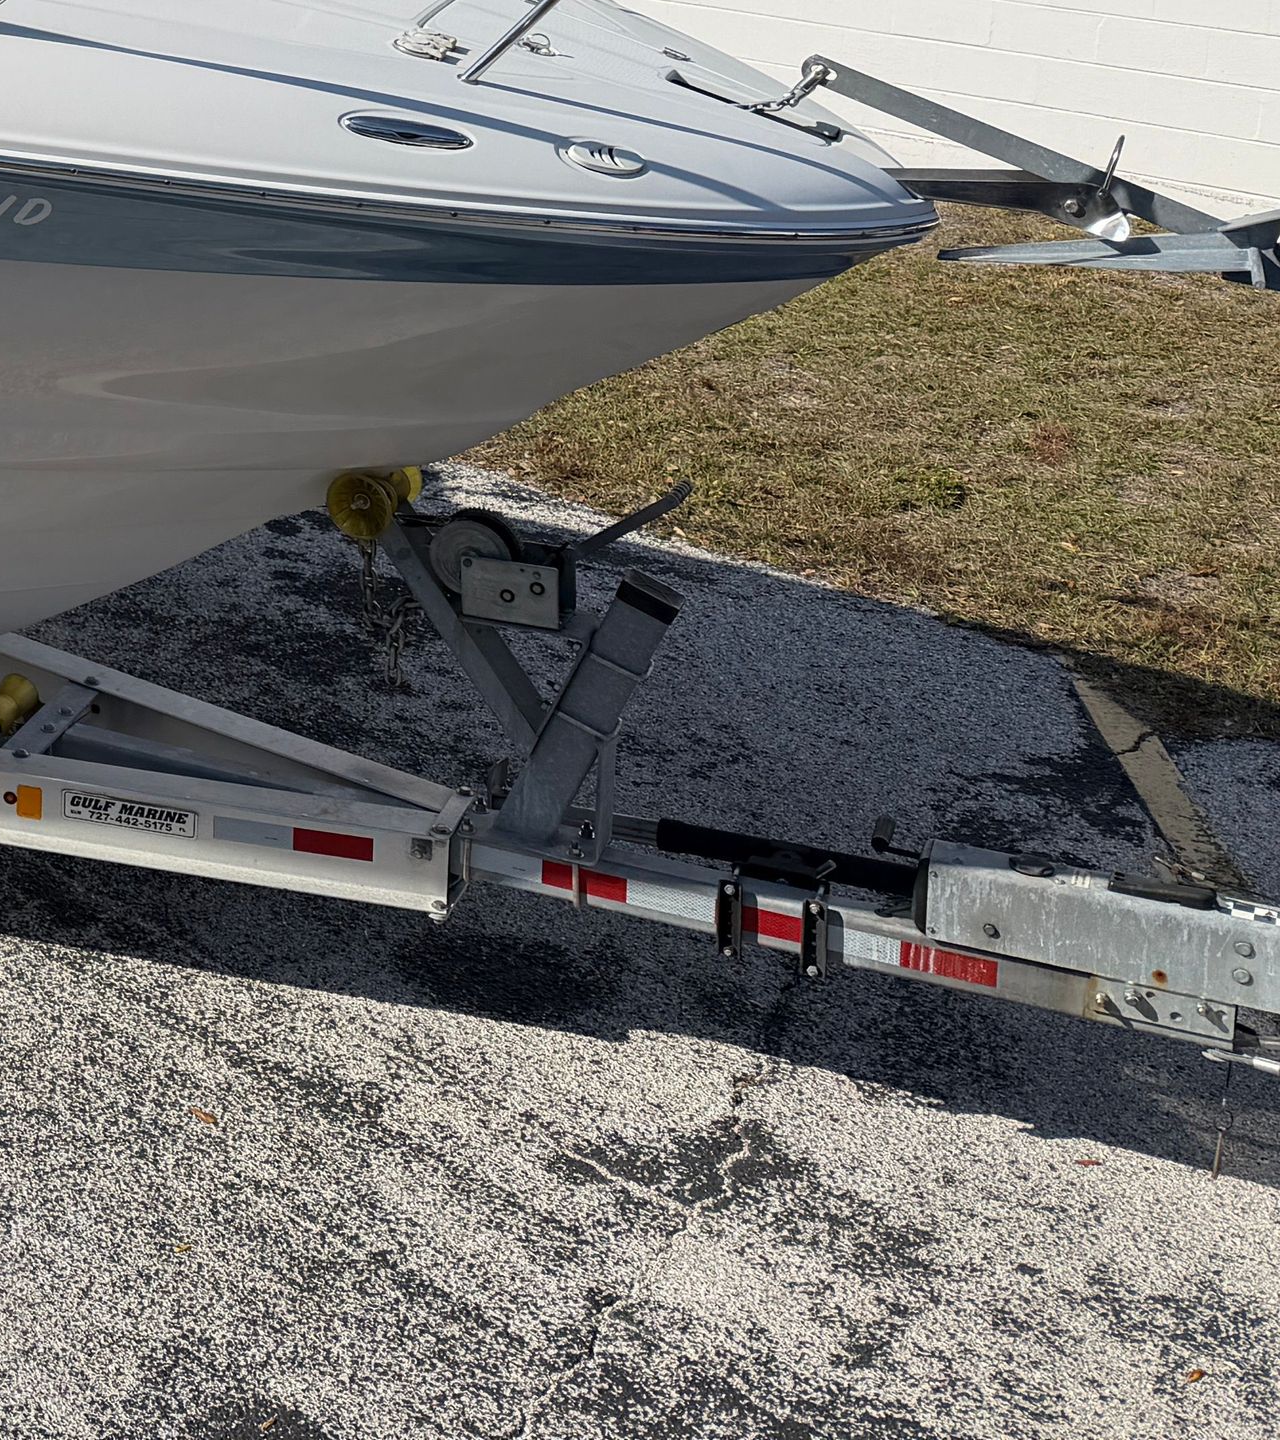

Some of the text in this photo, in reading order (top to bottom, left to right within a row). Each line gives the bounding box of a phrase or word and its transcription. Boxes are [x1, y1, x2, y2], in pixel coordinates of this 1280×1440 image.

[70, 796, 189, 825] GULF MARINE
[88, 810, 173, 832] 727-442-5175
